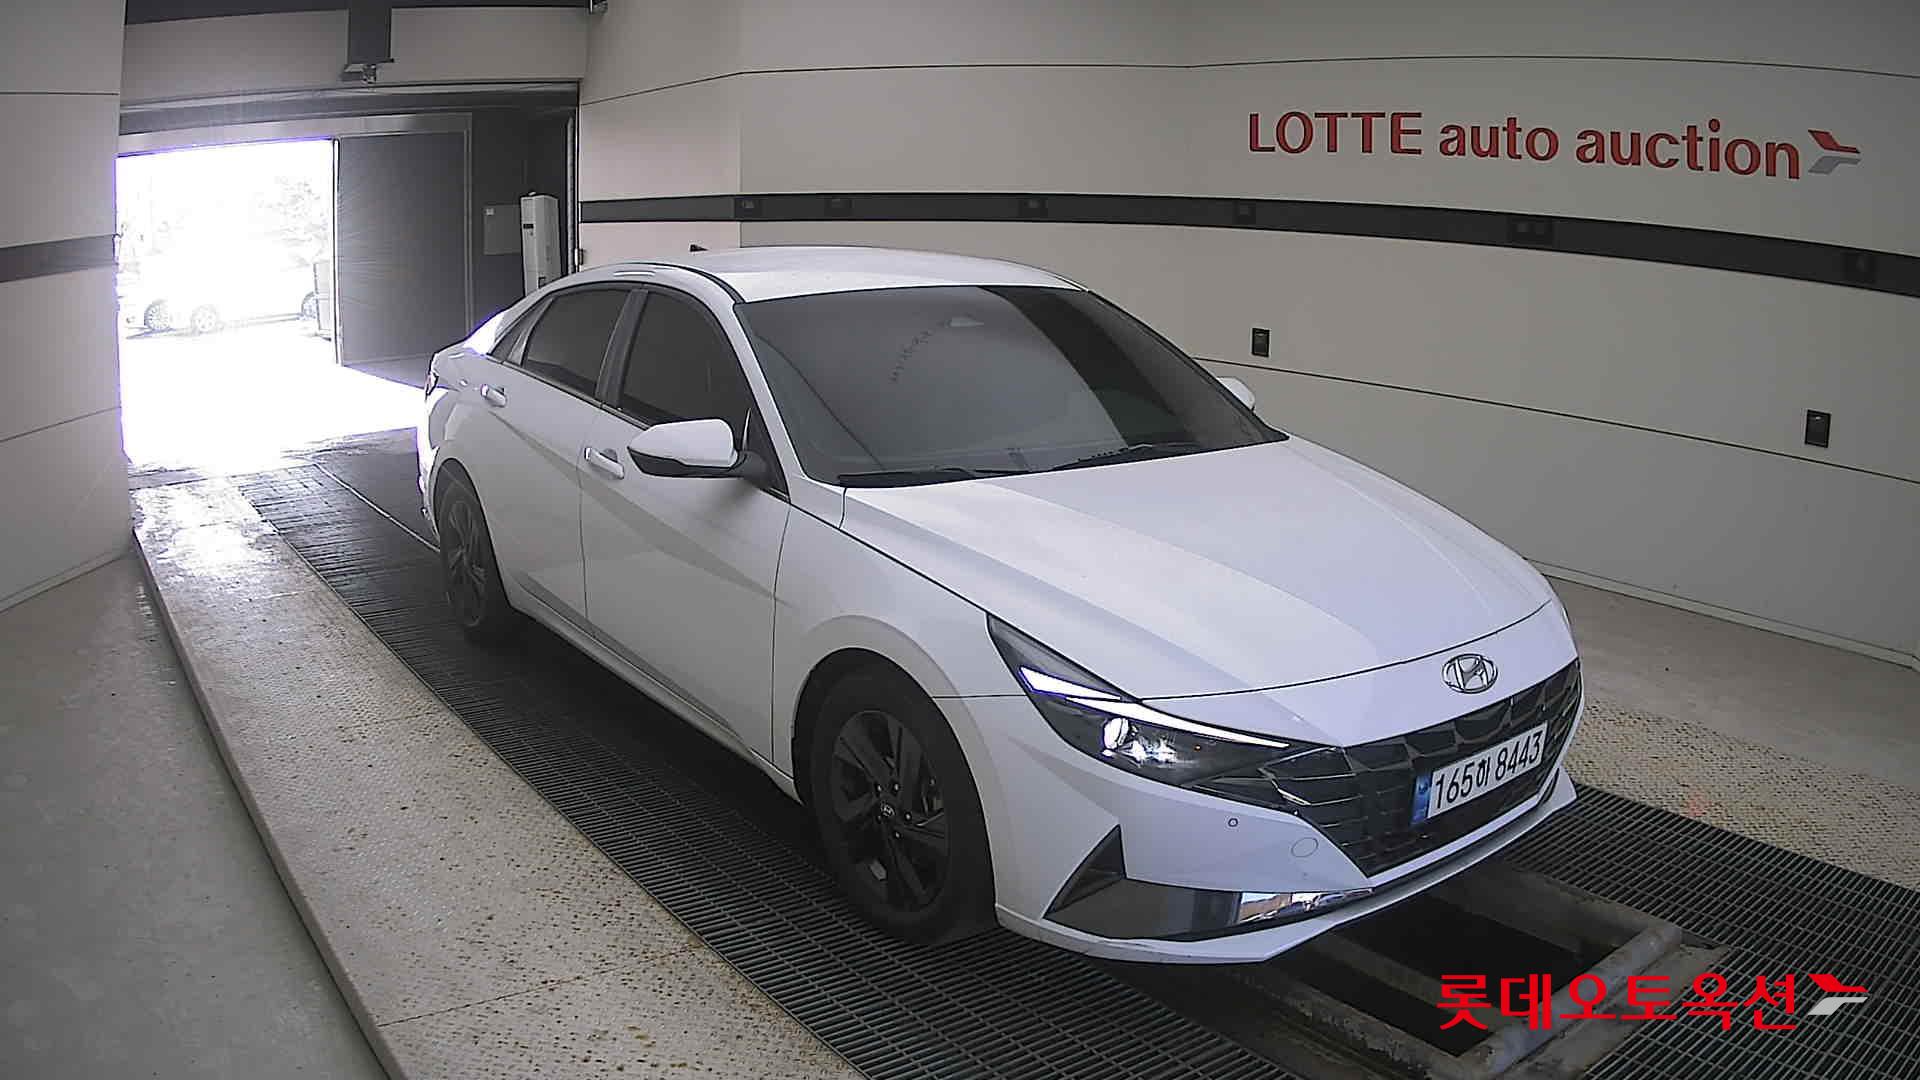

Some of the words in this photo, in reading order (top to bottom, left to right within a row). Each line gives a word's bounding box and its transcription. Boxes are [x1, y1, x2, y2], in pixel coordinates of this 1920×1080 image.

[1250, 112, 1421, 154] LOTTE
[1440, 118, 1558, 160] auto
[1576, 119, 1799, 179] auction
[1495, 730, 1544, 781] 8443
